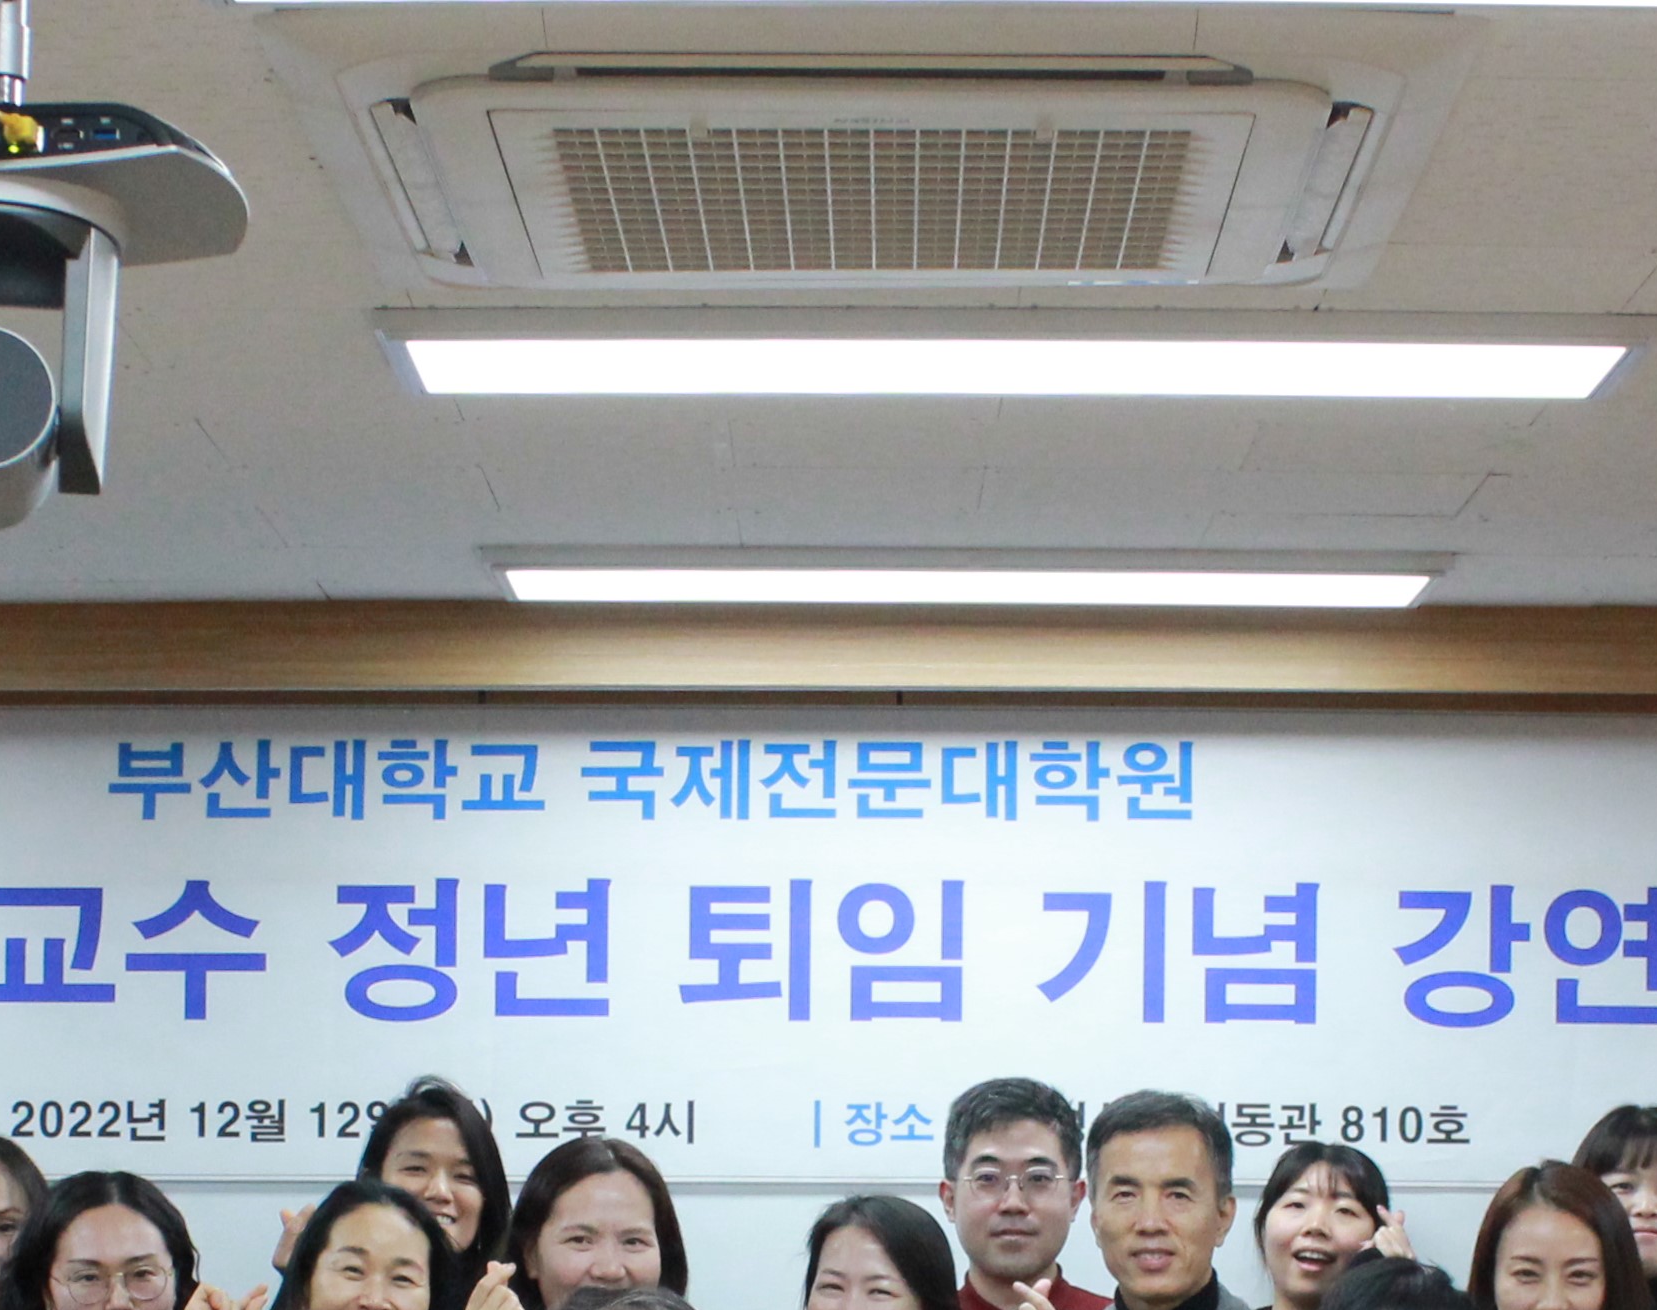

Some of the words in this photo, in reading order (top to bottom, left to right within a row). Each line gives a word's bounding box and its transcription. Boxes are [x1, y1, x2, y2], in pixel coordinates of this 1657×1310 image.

[109, 739, 546, 820] 부산대학교
[581, 740, 1193, 822] 국제전문대학원
[330, 878, 611, 1023] 정년
[680, 880, 964, 1025] 퇴임
[1041, 881, 1320, 1026] 기념
[10, 1098, 167, 1143] 2022년
[189, 1098, 286, 1143] 12월
[515, 1099, 607, 1140] 오후
[625, 1099, 695, 1144] 4시
[844, 1101, 936, 1147] 장소
[1340, 1104, 1472, 1144] 810호
